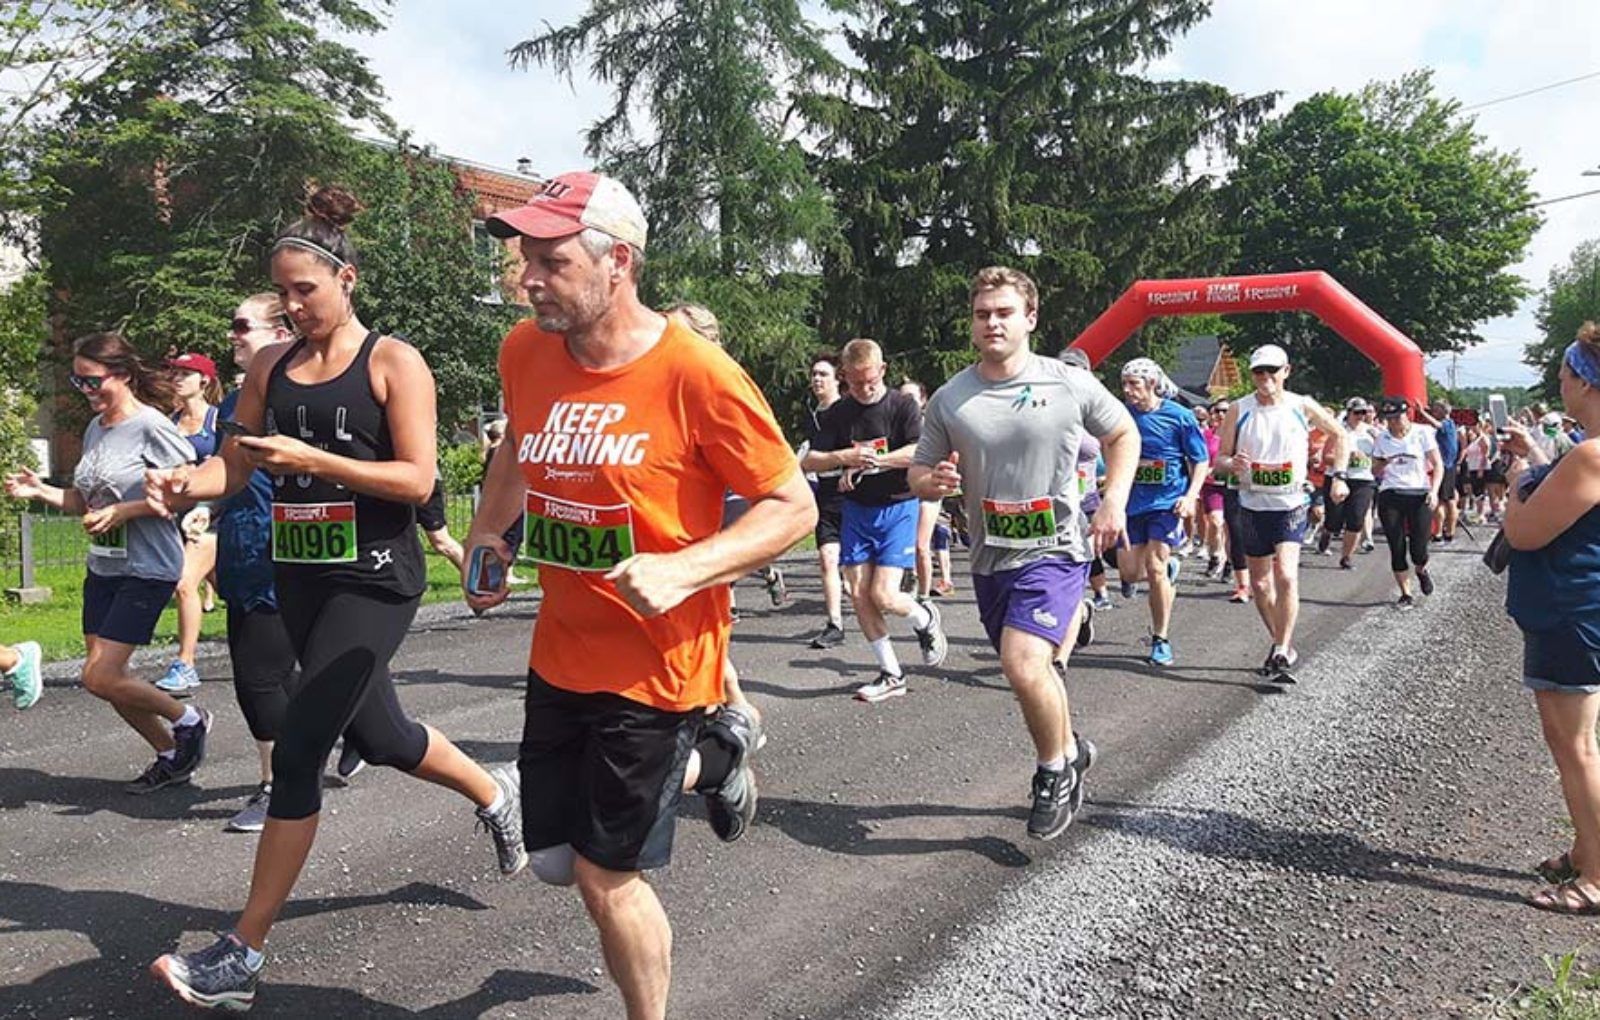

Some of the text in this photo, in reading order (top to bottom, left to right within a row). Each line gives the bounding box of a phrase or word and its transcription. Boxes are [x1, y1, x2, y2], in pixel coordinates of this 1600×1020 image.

[543, 402, 627, 434] KEEP
[518, 432, 650, 466] BURNING
[1252, 470, 1292, 486] 4035
[276, 523, 347, 560] 4096
[987, 512, 1049, 539] 4234
[529, 518, 623, 567] 4034
